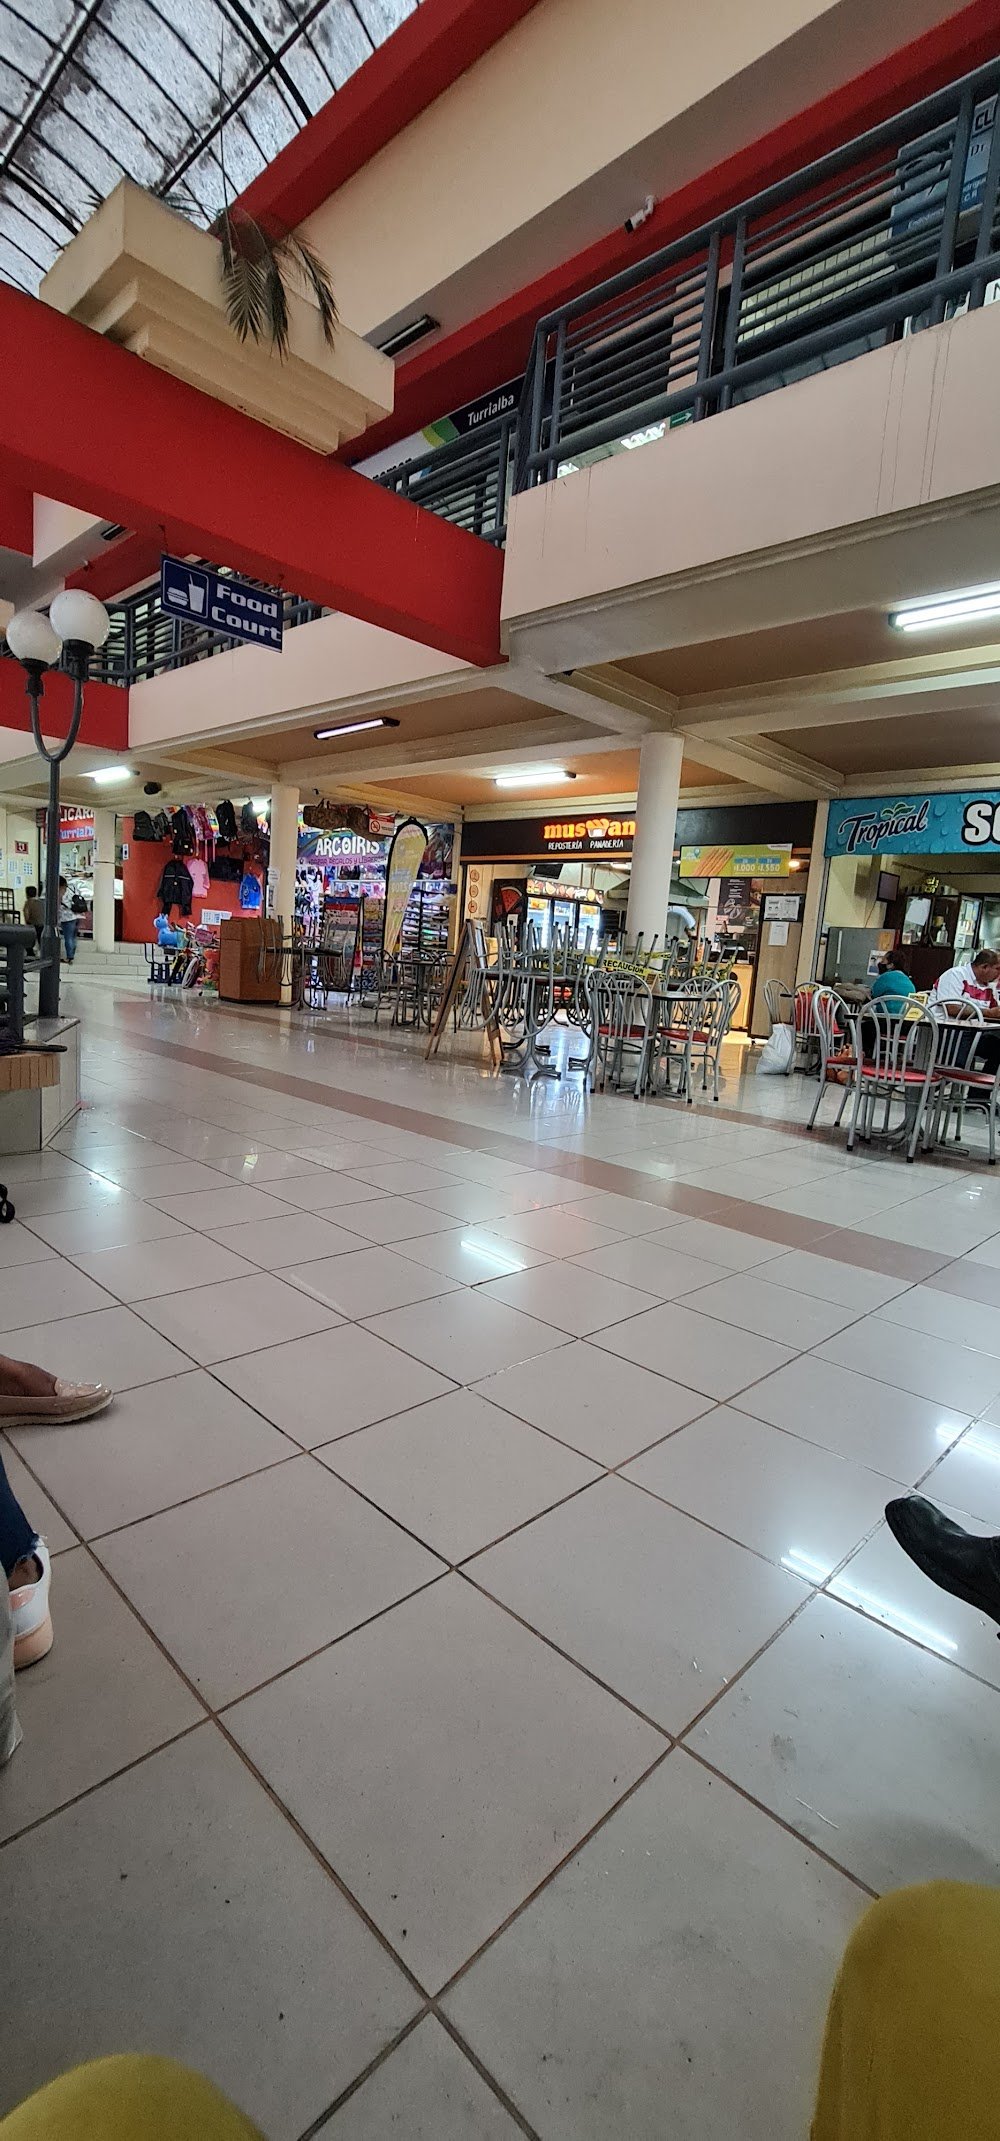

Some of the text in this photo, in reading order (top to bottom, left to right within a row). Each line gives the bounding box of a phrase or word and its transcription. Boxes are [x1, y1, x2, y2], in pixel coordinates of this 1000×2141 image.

[467, 394, 514, 426] Turrialba
[217, 584, 277, 618] Food
[211, 606, 282, 642] Court
[838, 799, 930, 853] Tropical
[961, 799, 1000, 845] S
[315, 836, 380, 857] ARCOIRIS
